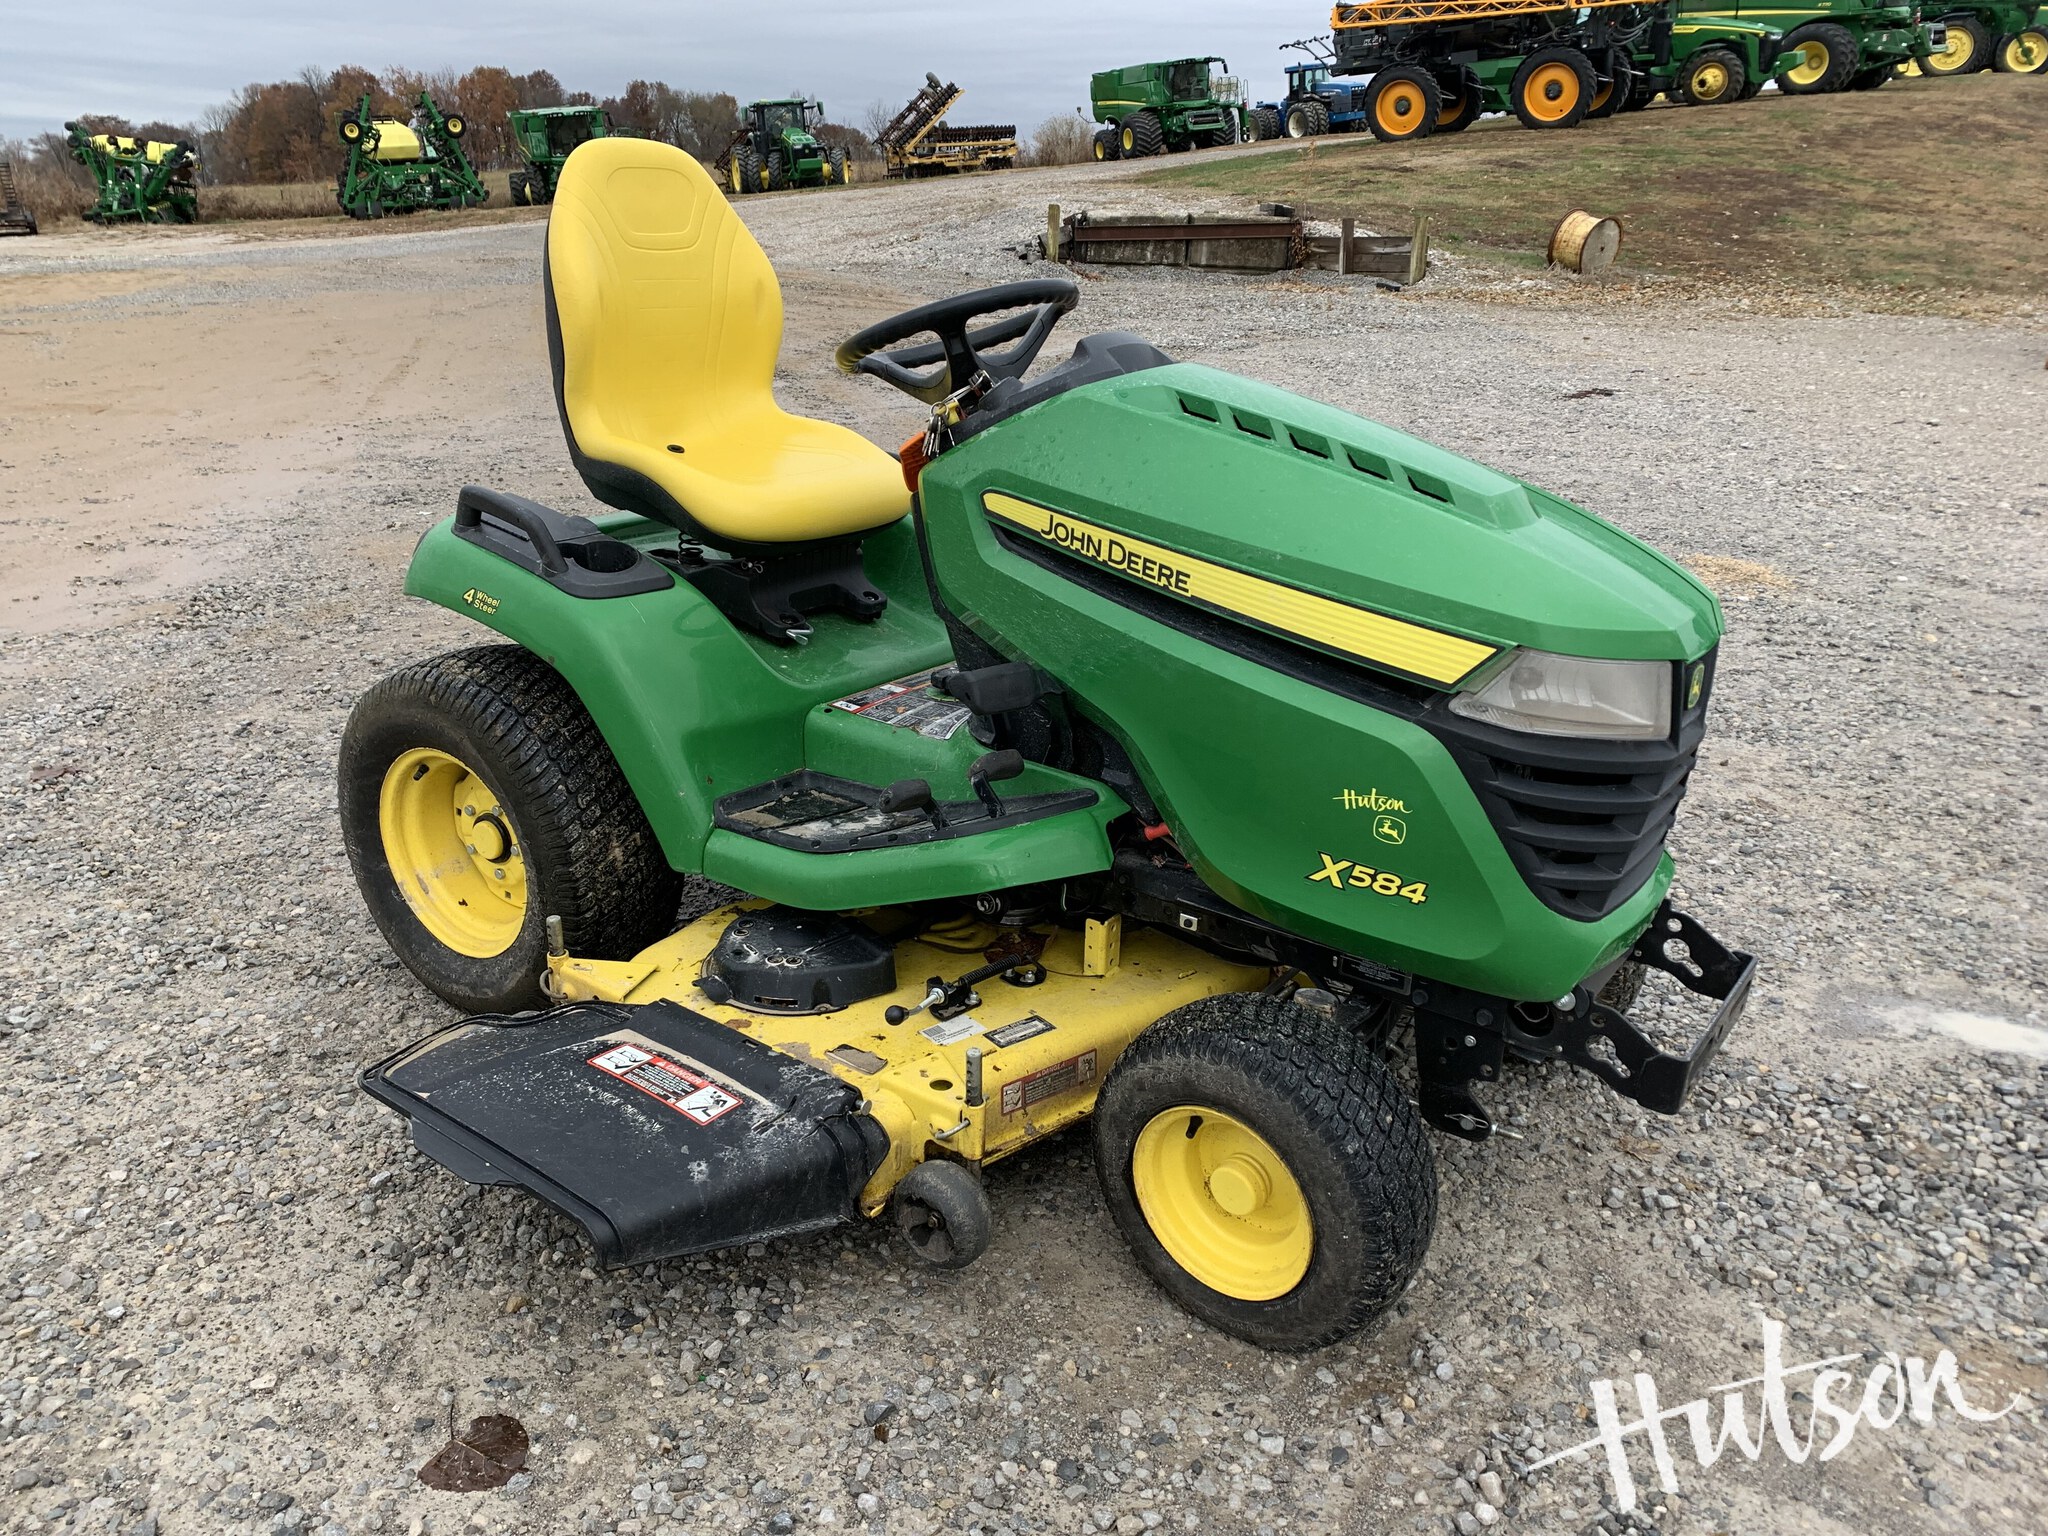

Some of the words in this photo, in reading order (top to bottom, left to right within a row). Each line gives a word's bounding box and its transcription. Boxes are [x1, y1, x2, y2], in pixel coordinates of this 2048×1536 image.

[1040, 514, 1103, 560] JOHN
[1107, 538, 1192, 596] DEERE
[463, 588, 475, 604] 4
[476, 590, 501, 608] Wheel
[473, 599, 497, 615] Steer
[1332, 787, 1413, 814] Hutson
[1305, 851, 1429, 905] X584
[664, 1064, 703, 1085] DANGER
